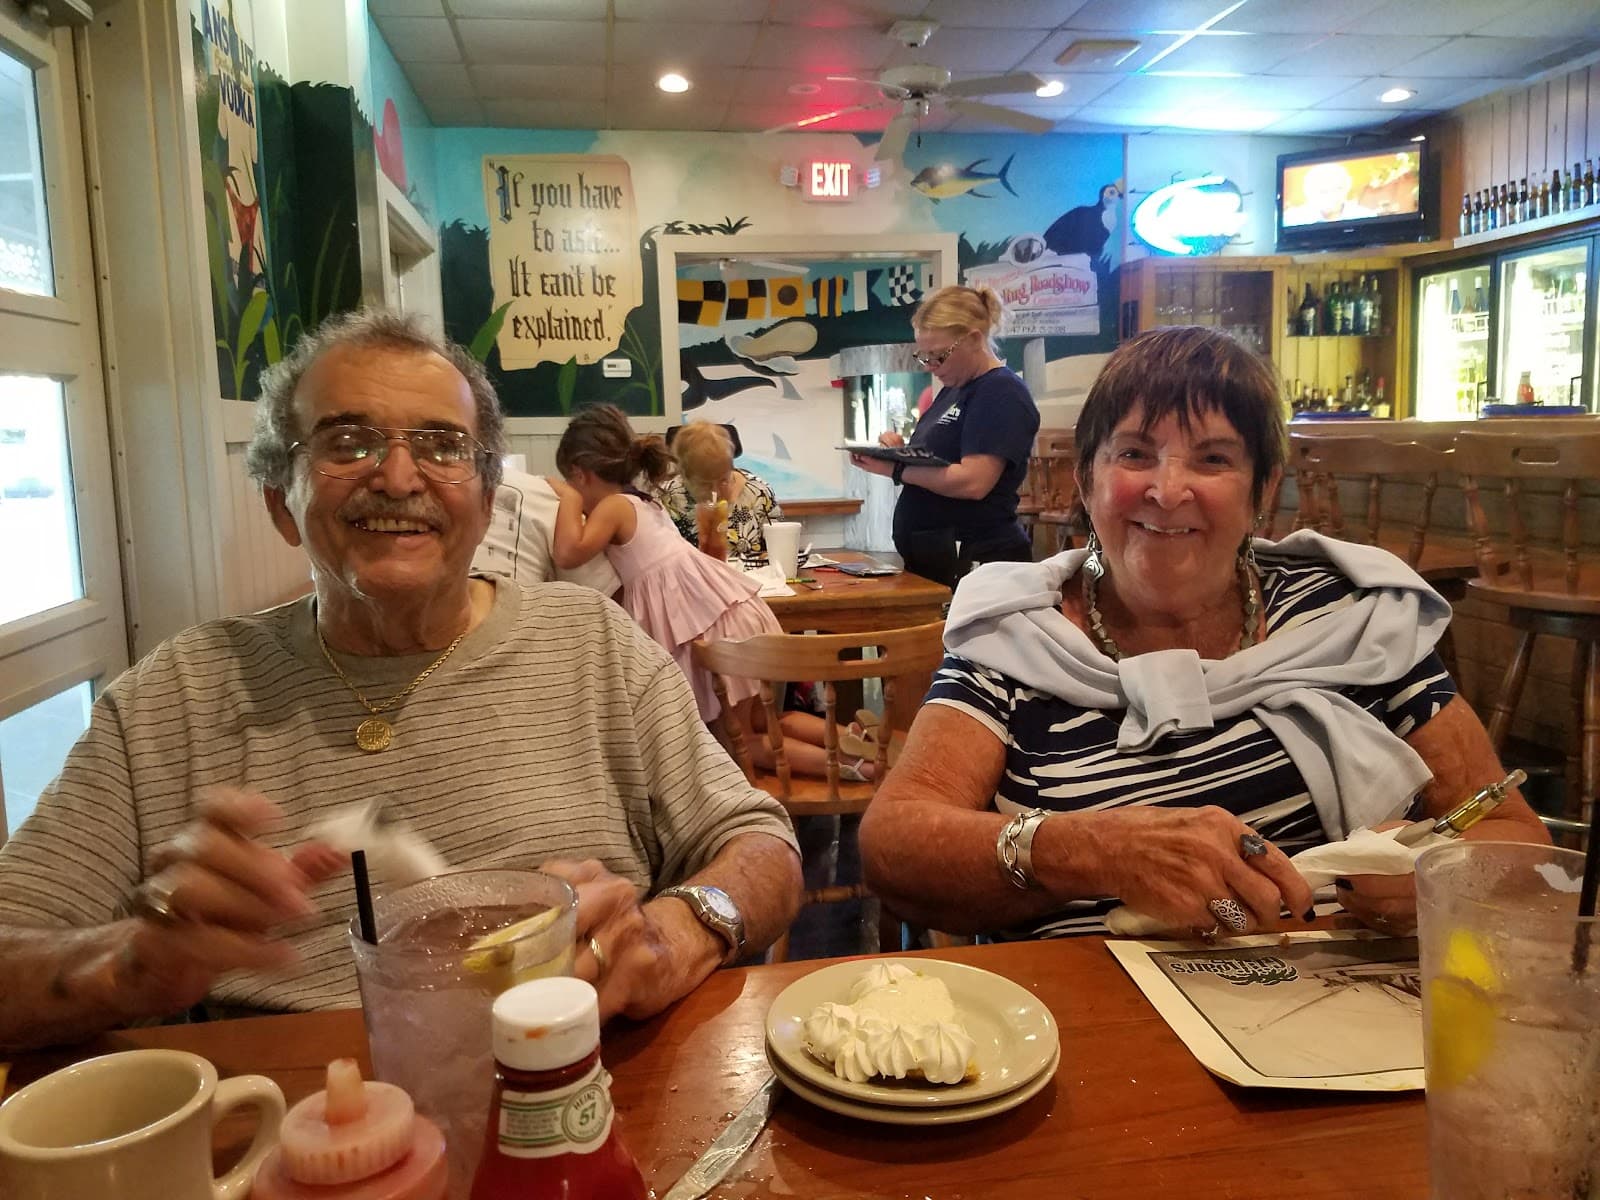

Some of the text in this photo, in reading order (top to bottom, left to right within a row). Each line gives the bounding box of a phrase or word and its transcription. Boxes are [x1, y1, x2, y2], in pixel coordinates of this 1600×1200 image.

[218, 68, 255, 129] VODKA
[529, 183, 572, 216] you
[577, 171, 623, 210] have
[811, 162, 851, 196] EXIT
[532, 219, 555, 252] to
[509, 255, 616, 298] It can't be
[573, 1091, 597, 1111] HEINZ
[579, 1101, 597, 1126] 57
